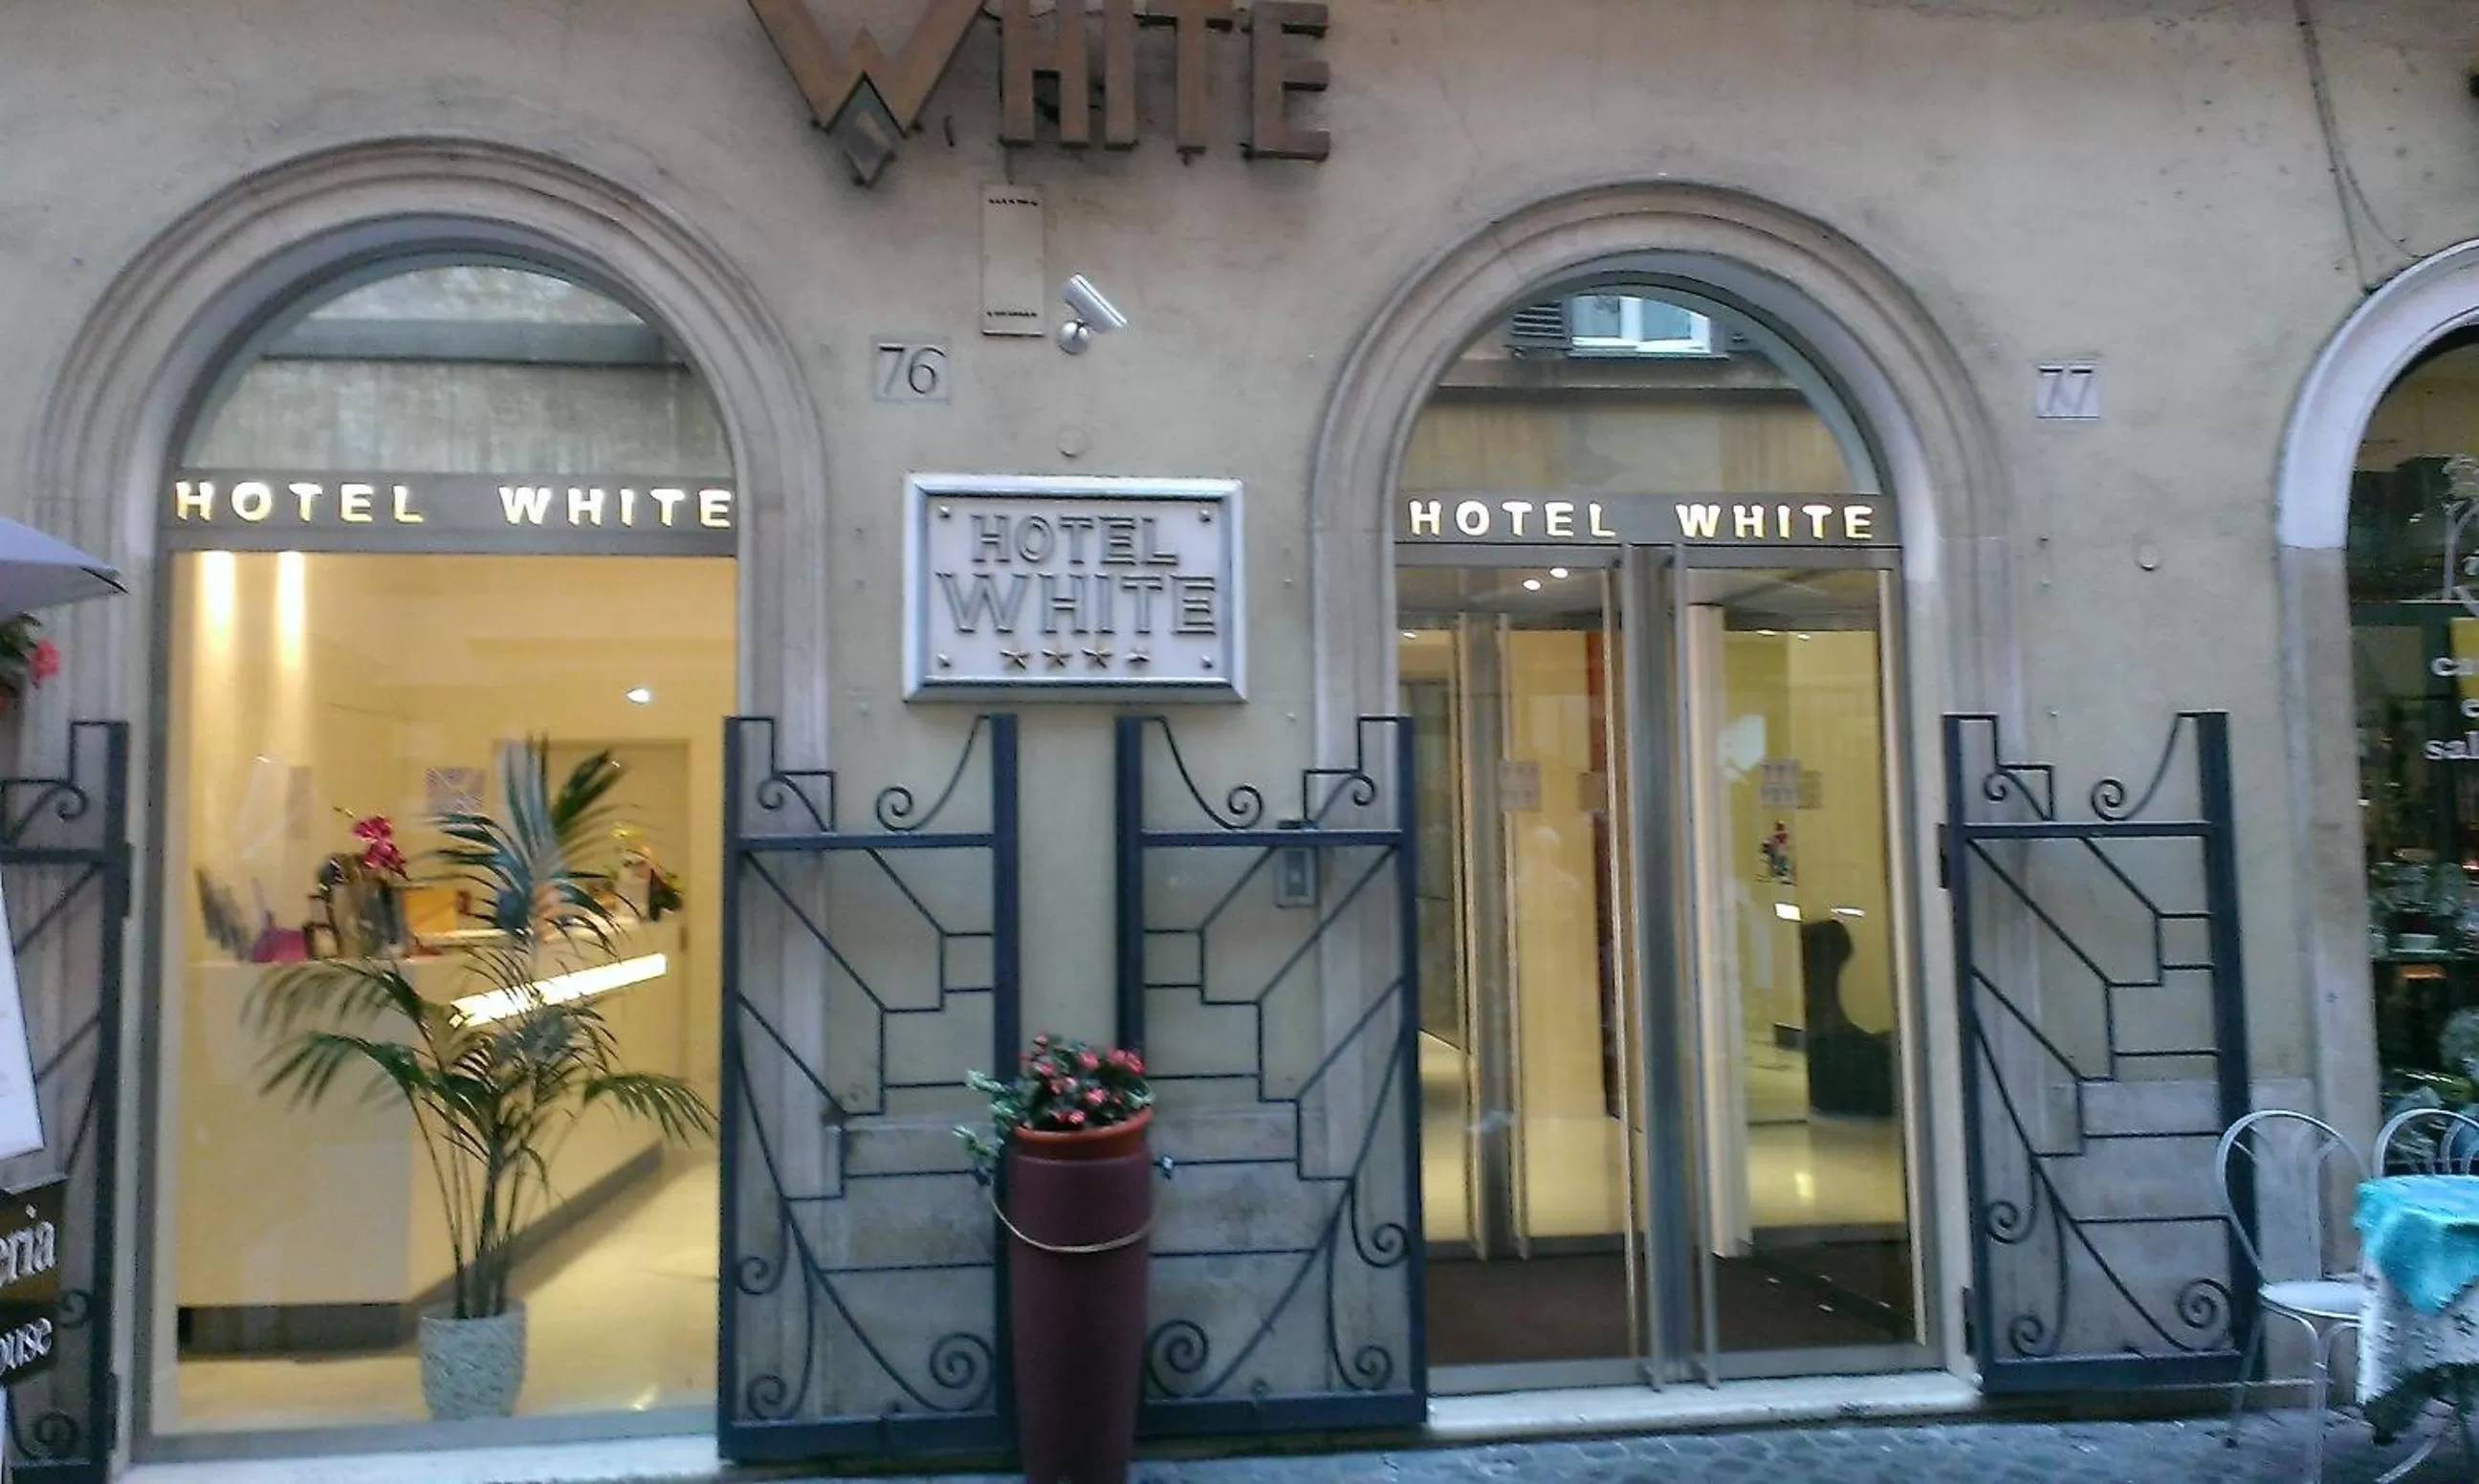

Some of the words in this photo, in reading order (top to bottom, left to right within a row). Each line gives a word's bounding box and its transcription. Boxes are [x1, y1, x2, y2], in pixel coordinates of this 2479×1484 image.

[748, 0, 1330, 163] WHITE
[879, 343, 946, 396] 76
[2039, 365, 2094, 414] 77
[174, 480, 424, 523] HOTEL
[498, 486, 733, 528] WHITE
[1409, 500, 1616, 538] HOTEL
[1676, 503, 1875, 539] WHITE
[970, 514, 1178, 565] HOTEL
[934, 573, 1216, 634] WHITE
